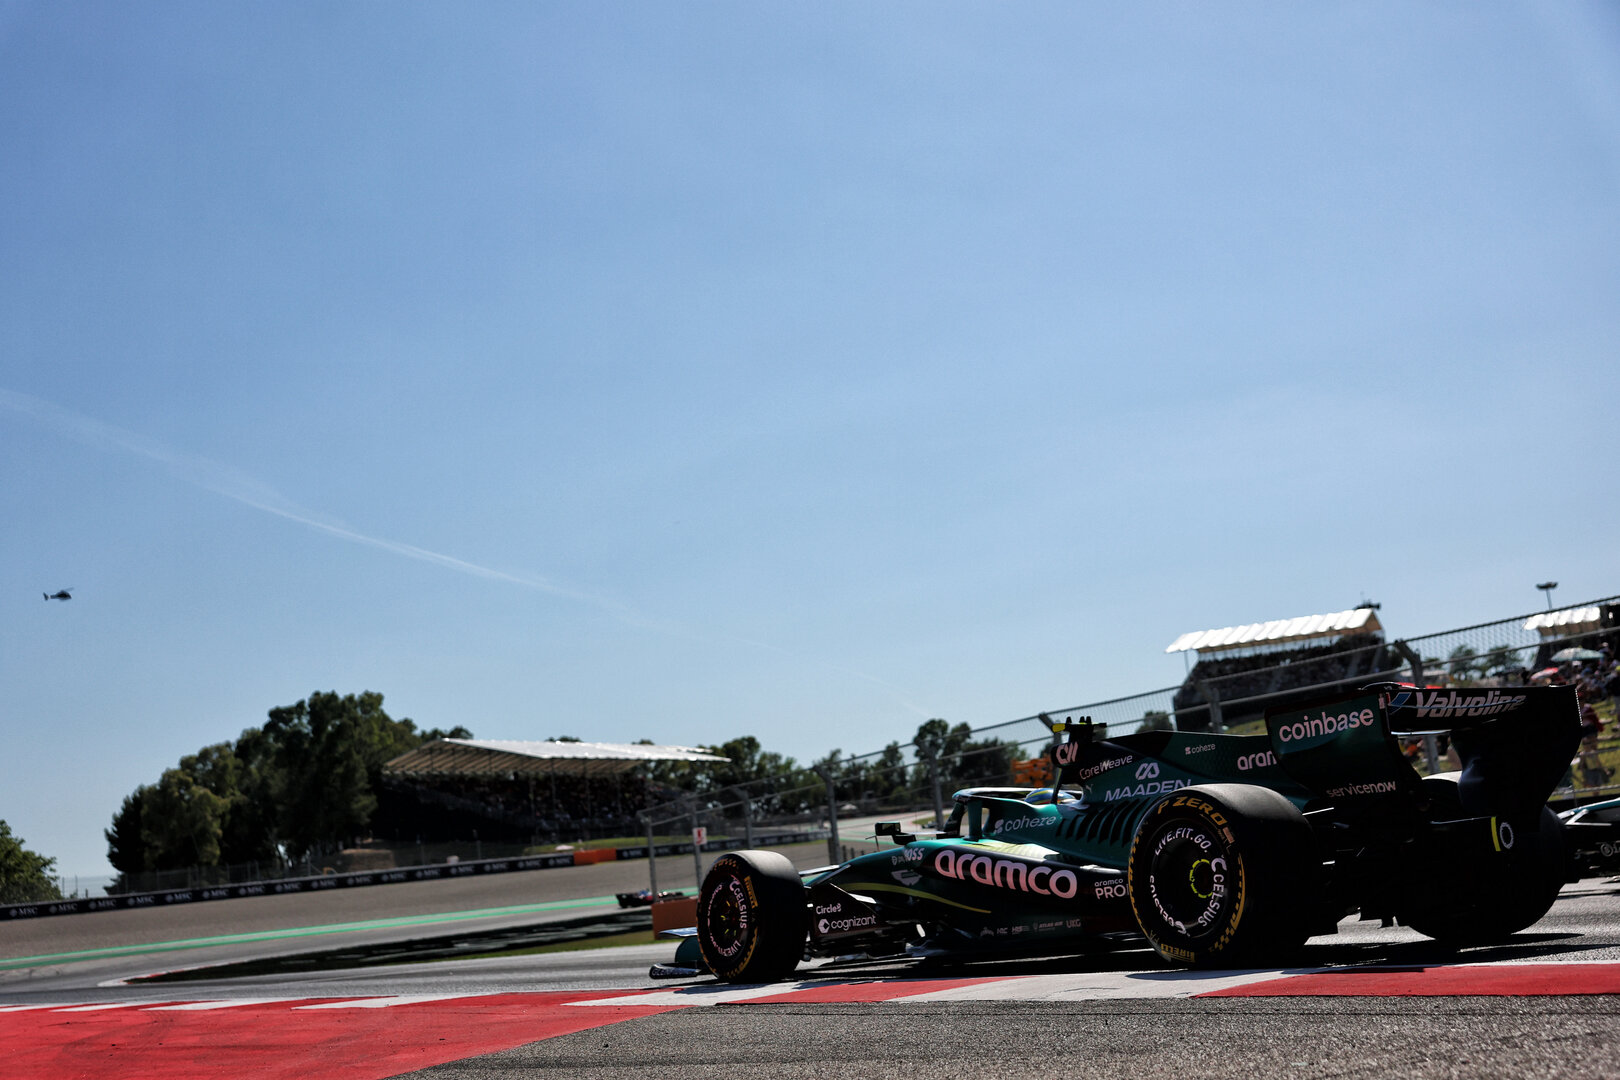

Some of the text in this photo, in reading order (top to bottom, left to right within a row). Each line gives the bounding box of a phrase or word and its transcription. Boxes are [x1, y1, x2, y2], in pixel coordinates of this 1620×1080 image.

[1415, 690, 1528, 718] Valvoline
[1278, 707, 1375, 743] coinbase
[1191, 743, 1216, 754] cohere
[1079, 754, 1133, 780] CoreWeave
[1104, 778, 1192, 802] MAADEN
[1326, 780, 1397, 799] servicenow
[1004, 815, 1056, 832] cohere
[1172, 796, 1228, 826] ZERO
[934, 850, 1078, 899] aramco
[1094, 878, 1123, 887] aramco
[733, 887, 748, 929] CELSIUS
[1197, 874, 1225, 927] CELSIUS
[831, 914, 877, 931] cognizant
